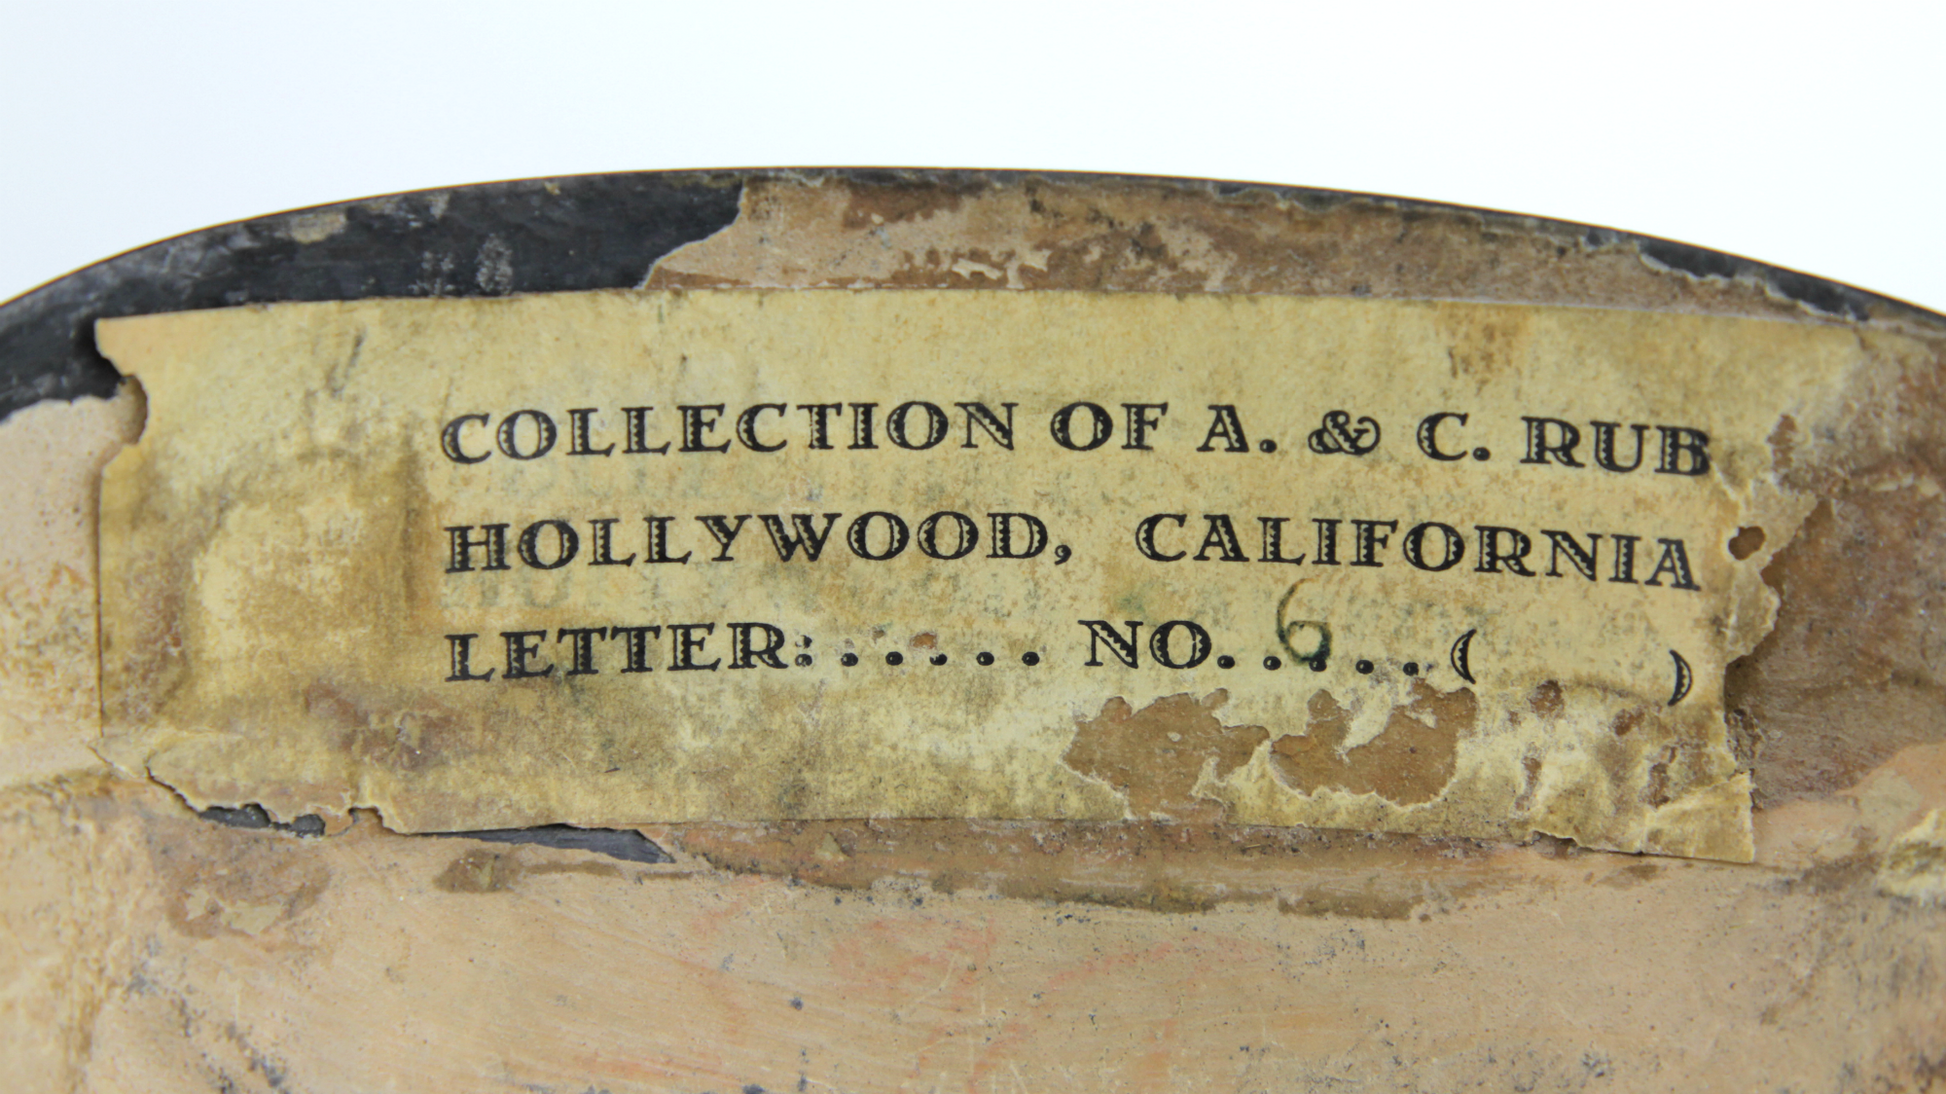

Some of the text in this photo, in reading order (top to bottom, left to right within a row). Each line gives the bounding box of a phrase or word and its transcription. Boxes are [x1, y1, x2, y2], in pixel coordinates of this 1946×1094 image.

[440, 400, 1018, 464] COLLECTION
[1050, 402, 1168, 452] OF
[1197, 404, 1278, 453] A.
[1308, 410, 1381, 456] &
[1416, 411, 1491, 461] C.
[444, 510, 1702, 591] HOLLYWOOD, CALIFORNIA
[1078, 619, 1235, 669] NO.
[1276, 577, 1333, 664] 6
